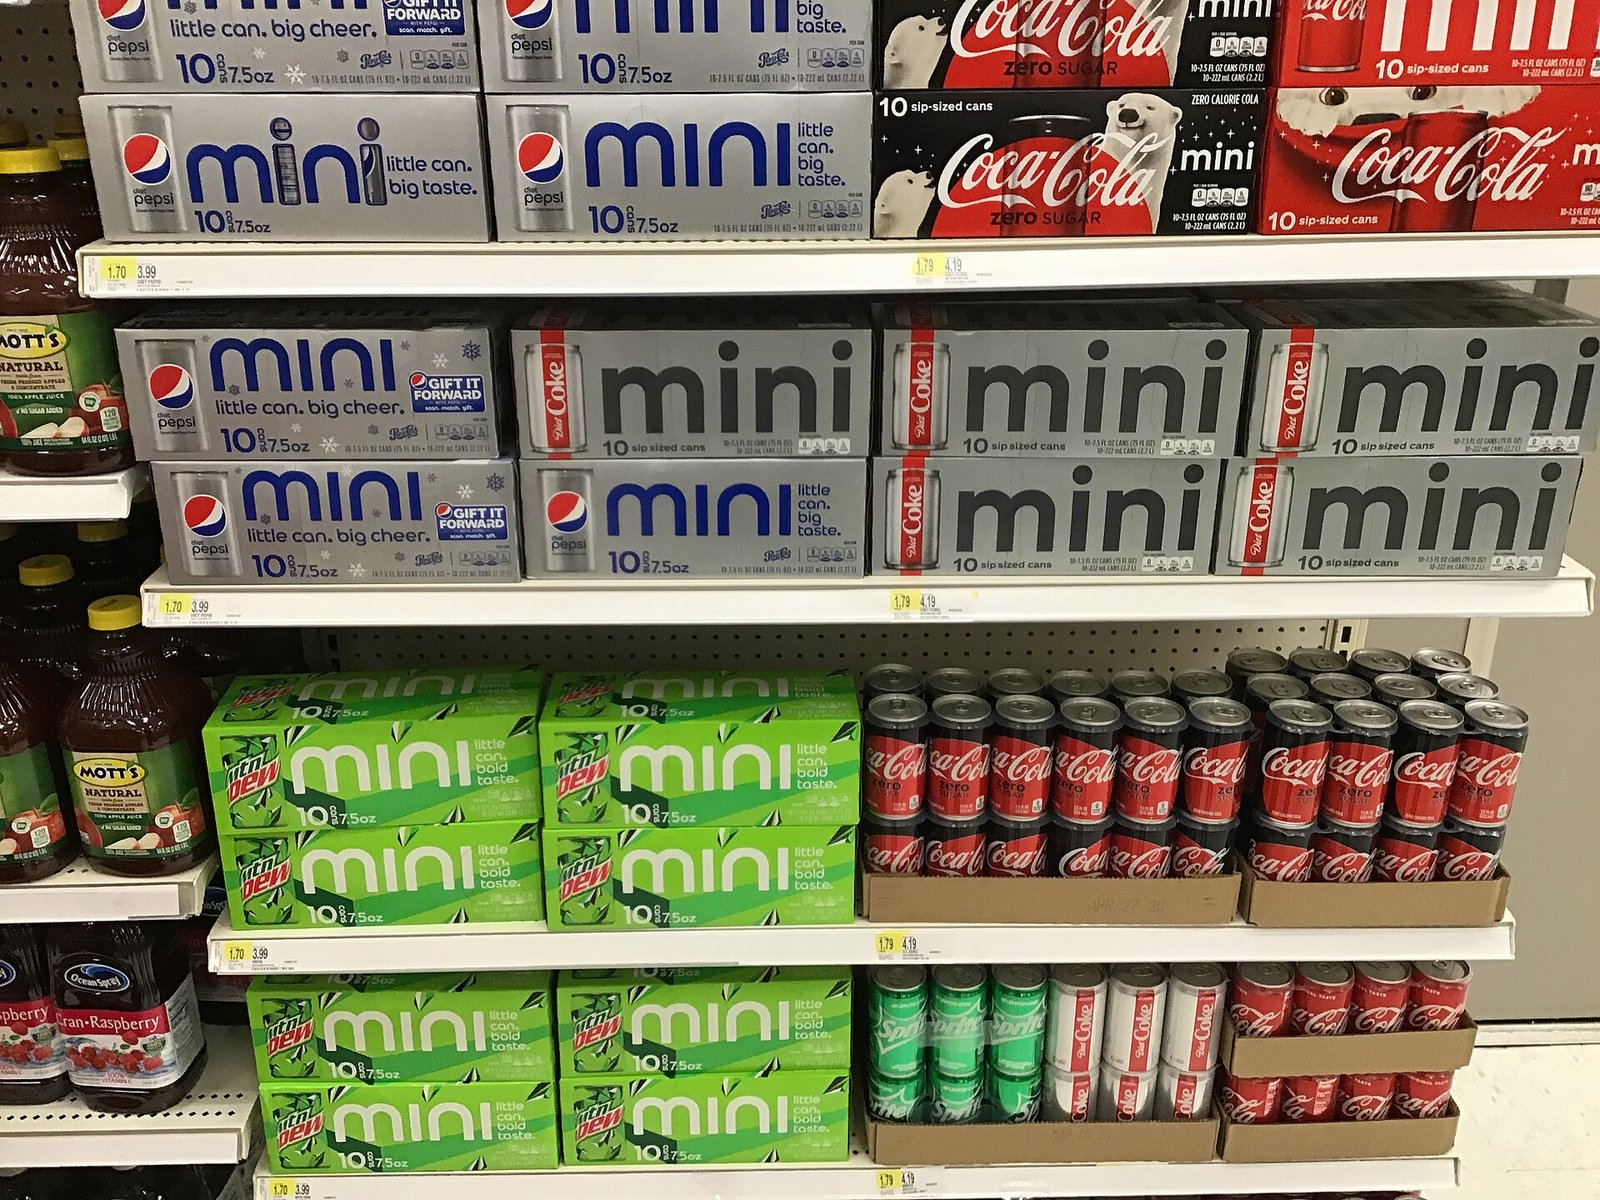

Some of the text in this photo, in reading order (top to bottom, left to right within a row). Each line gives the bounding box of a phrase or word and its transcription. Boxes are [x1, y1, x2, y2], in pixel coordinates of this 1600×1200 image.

[387, 8, 461, 20] FORWARD
[171, 19, 376, 42] little can. big cheer.
[797, 19, 846, 34] taste.
[108, 39, 149, 54] pepsi
[512, 38, 553, 53] pepsi
[176, 53, 215, 84] 10
[578, 53, 616, 84] 10
[1004, 61, 1118, 76] zero SUGAR
[1224, 64, 1237, 72] CANS
[1375, 58, 1489, 79] 10 sip-sized cans
[879, 98, 993, 117] 10 sip-sized cans
[1191, 94, 1258, 105] ZERO CALORIE COLA
[798, 122, 834, 138] little
[584, 121, 791, 187] mini
[1180, 140, 1255, 171] mini
[386, 156, 472, 172] little can.
[798, 156, 824, 174] big
[937, 133, 1176, 209] Coca-Cola
[1332, 127, 1568, 204] Coca-Cola
[798, 172, 846, 187] taste.
[389, 179, 478, 199] big taste.
[134, 192, 174, 207] pepsi
[524, 191, 564, 206] pepsi
[194, 210, 225, 233] 10
[588, 205, 625, 234] 10
[990, 211, 1101, 226] zero SUGAR
[1268, 212, 1378, 231] 10 sip-sized cans
[108, 266, 126, 278] 1.70
[138, 266, 156, 278] 3.99
[209, 338, 396, 392] mini
[546, 361, 565, 416] Coke
[602, 340, 853, 434] mini
[911, 359, 932, 413] Coke
[966, 339, 1227, 433] mini
[1283, 360, 1309, 415] Coke
[1337, 337, 1600, 432] mini
[414, 390, 481, 400] FORWARD
[216, 400, 405, 418] little big cheer.
[158, 416, 196, 429] pepsi
[603, 440, 629, 456] 10
[963, 438, 988, 453] 10
[1332, 438, 1358, 454] 10
[242, 470, 422, 522] mini
[798, 484, 831, 497] little
[606, 483, 792, 536] mini
[902, 484, 923, 535] Coke
[956, 464, 1205, 552] mini
[1249, 481, 1274, 533] Coke
[1302, 462, 1562, 550] mini
[440, 520, 504, 529] FORWARD
[798, 512, 822, 526] big
[247, 529, 430, 546] little big cheer.
[953, 558, 978, 572] 10
[1298, 555, 1323, 570] 10
[165, 601, 182, 613] 1.70
[192, 601, 209, 613] 3.99
[895, 596, 910, 608] 1.79
[920, 596, 935, 608] 4.19
[80, 766, 138, 779] MOTT'S
[290, 741, 471, 795] mini
[619, 744, 791, 792] mini
[85, 788, 141, 797] NATURAL
[939, 780, 969, 791] zero
[301, 846, 475, 895] mini
[621, 847, 789, 894] mini
[879, 938, 893, 949] 1.79
[902, 938, 917, 949] 4.19
[229, 949, 244, 959] 1.70
[252, 948, 268, 959] 3.99
[71, 973, 121, 988] Ocean Spray
[631, 1001, 790, 1045] mini
[1075, 1003, 1093, 1041] Coke
[1134, 1003, 1152, 1041] Coke
[1194, 1003, 1213, 1041] Coke
[323, 1011, 486, 1052] mini
[334, 1102, 493, 1143] mini
[633, 1095, 788, 1136] mini
[880, 1174, 893, 1186] 1.79
[901, 1172, 915, 1185] 4.19
[274, 1185, 287, 1195] 1.70
[296, 1185, 309, 1194] 3.99
